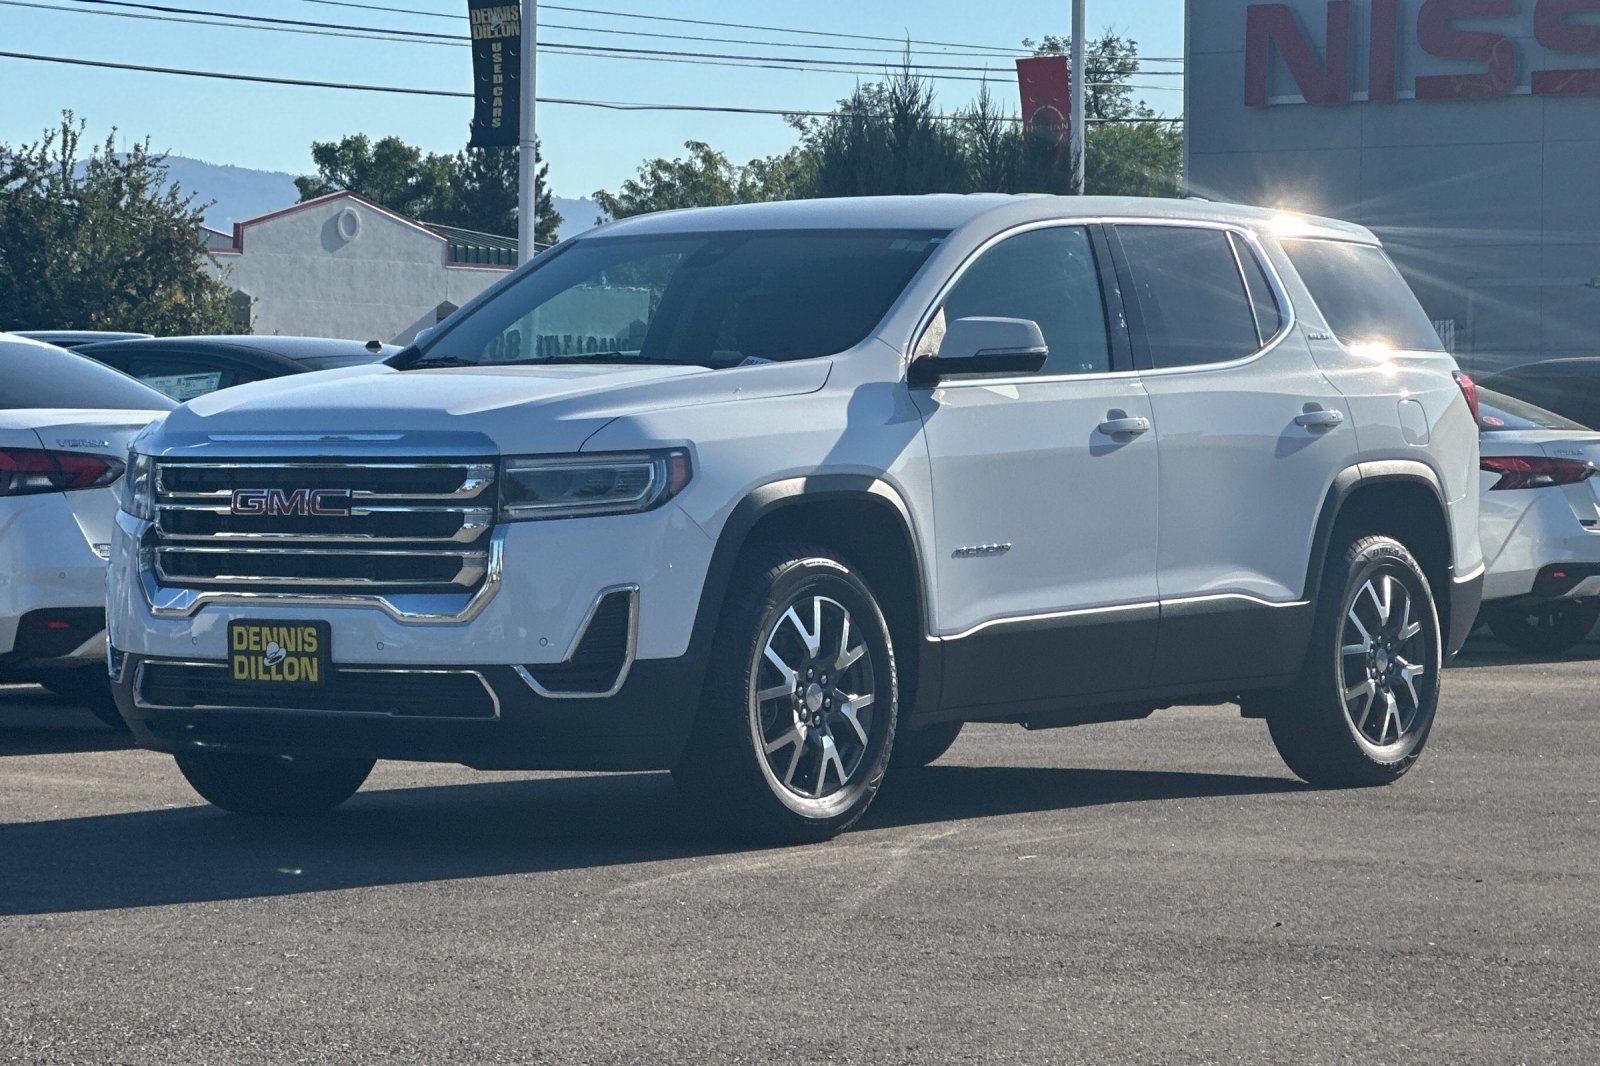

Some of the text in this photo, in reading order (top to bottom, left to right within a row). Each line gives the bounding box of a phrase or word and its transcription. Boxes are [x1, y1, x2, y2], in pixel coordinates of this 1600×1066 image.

[471, 5, 519, 25] DENNIS
[473, 20, 520, 40] DILLON
[1244, 0, 1600, 107] NISS
[491, 42, 503, 128] USED CARS
[231, 488, 351, 517] GMC
[232, 625, 318, 653] DENNIS
[233, 654, 319, 682] DILLON
